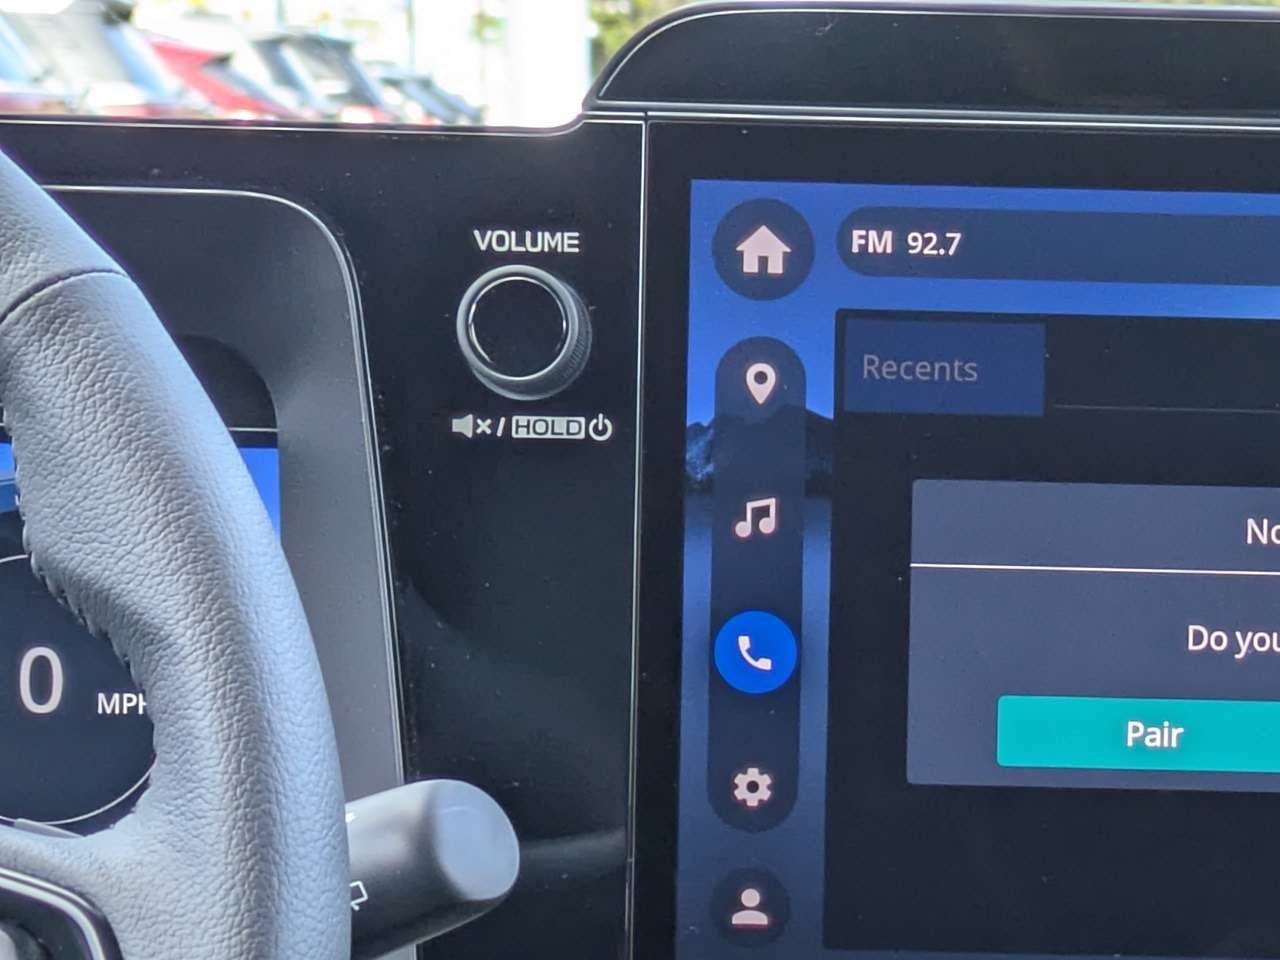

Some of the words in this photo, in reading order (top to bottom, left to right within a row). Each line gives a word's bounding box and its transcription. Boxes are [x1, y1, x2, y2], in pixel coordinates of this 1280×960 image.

[473, 229, 580, 253] VOLUME
[851, 229, 893, 254] FM
[907, 231, 962, 256] 92.7
[863, 354, 978, 382] Recents
[514, 418, 583, 437] HOLD
[1188, 624, 1228, 651] Do
[19, 645, 64, 715] 0
[1127, 720, 1185, 748] Pair
